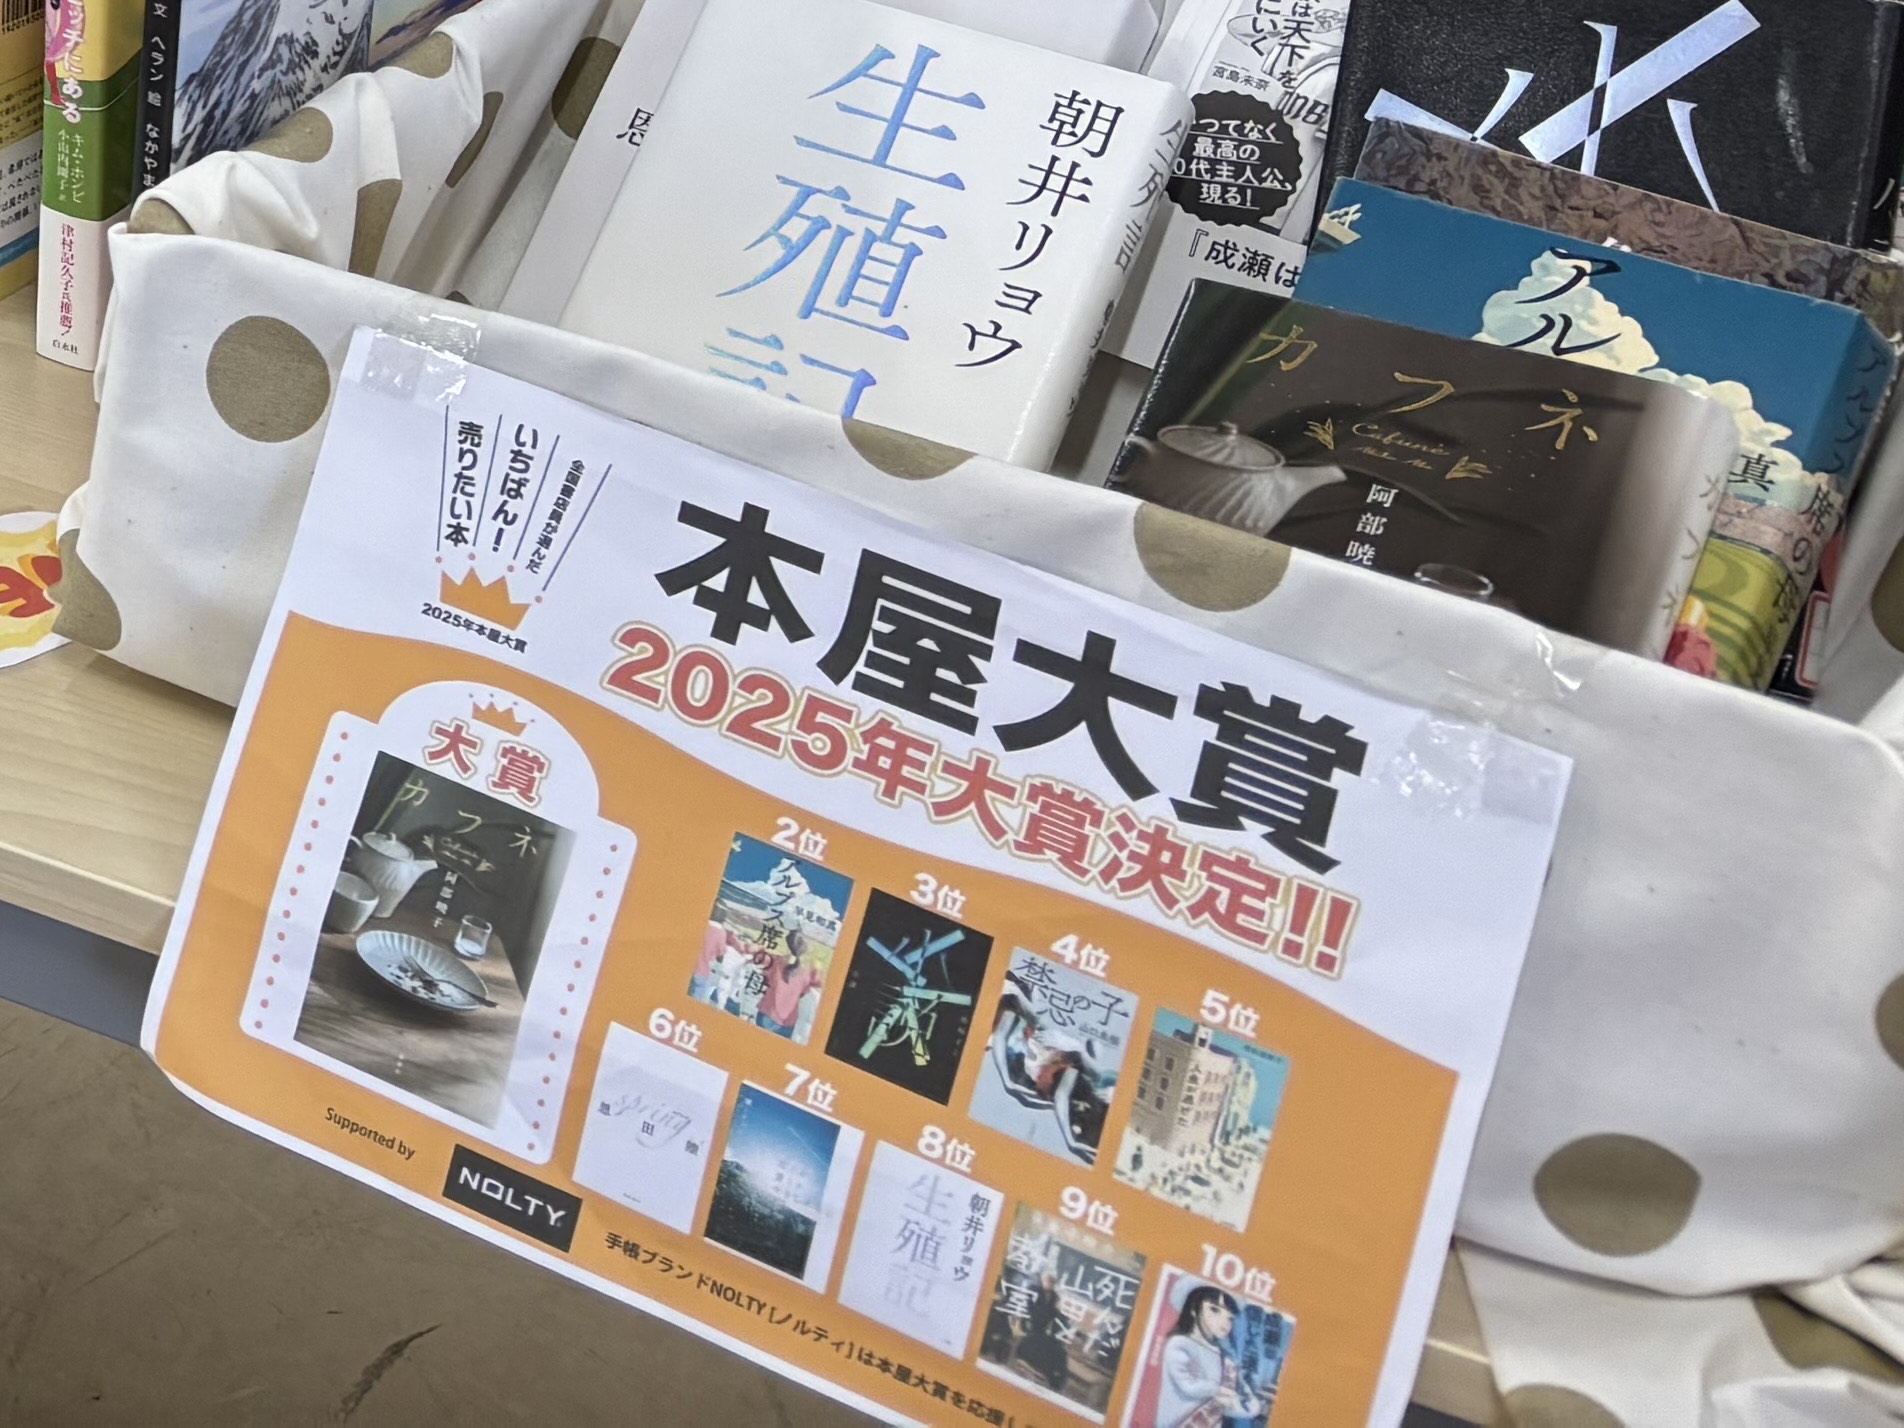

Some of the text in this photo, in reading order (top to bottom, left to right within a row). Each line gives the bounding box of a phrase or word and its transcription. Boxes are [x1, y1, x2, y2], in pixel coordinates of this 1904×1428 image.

[1210, 64, 1271, 91] 宮島未奈
[1193, 134, 1261, 165] 最高の
[1198, 181, 1256, 211] 現る!
[953, 89, 1127, 369] 朝井リョウ
[1248, 322, 1602, 453] カフネ
[442, 420, 485, 549] 売りたい本
[490, 422, 540, 553] いちばん!
[525, 458, 586, 575] 全国書店員が選んだ
[420, 601, 529, 656] 2025年本屋大賞
[655, 500, 1368, 875] 本屋大賞
[423, 720, 550, 807] 大賞
[398, 778, 539, 858] カフネ
[601, 620, 1363, 980] 2025年大賞決定!!
[771, 816, 830, 862] 2位
[909, 872, 967, 920] 3位
[743, 857, 800, 996] アルプス席の母
[1050, 933, 1113, 981] 4位
[1014, 954, 1129, 1029] 禁忌の子
[1199, 988, 1261, 1039] 5位
[648, 1006, 705, 1055] 6位
[782, 1063, 841, 1113] 7位
[324, 1105, 417, 1163] Supported by
[916, 1124, 977, 1174] 8位
[457, 1164, 568, 1229] NOLTY
[1059, 1186, 1121, 1236] 9位
[1200, 1242, 1278, 1305] 10位
